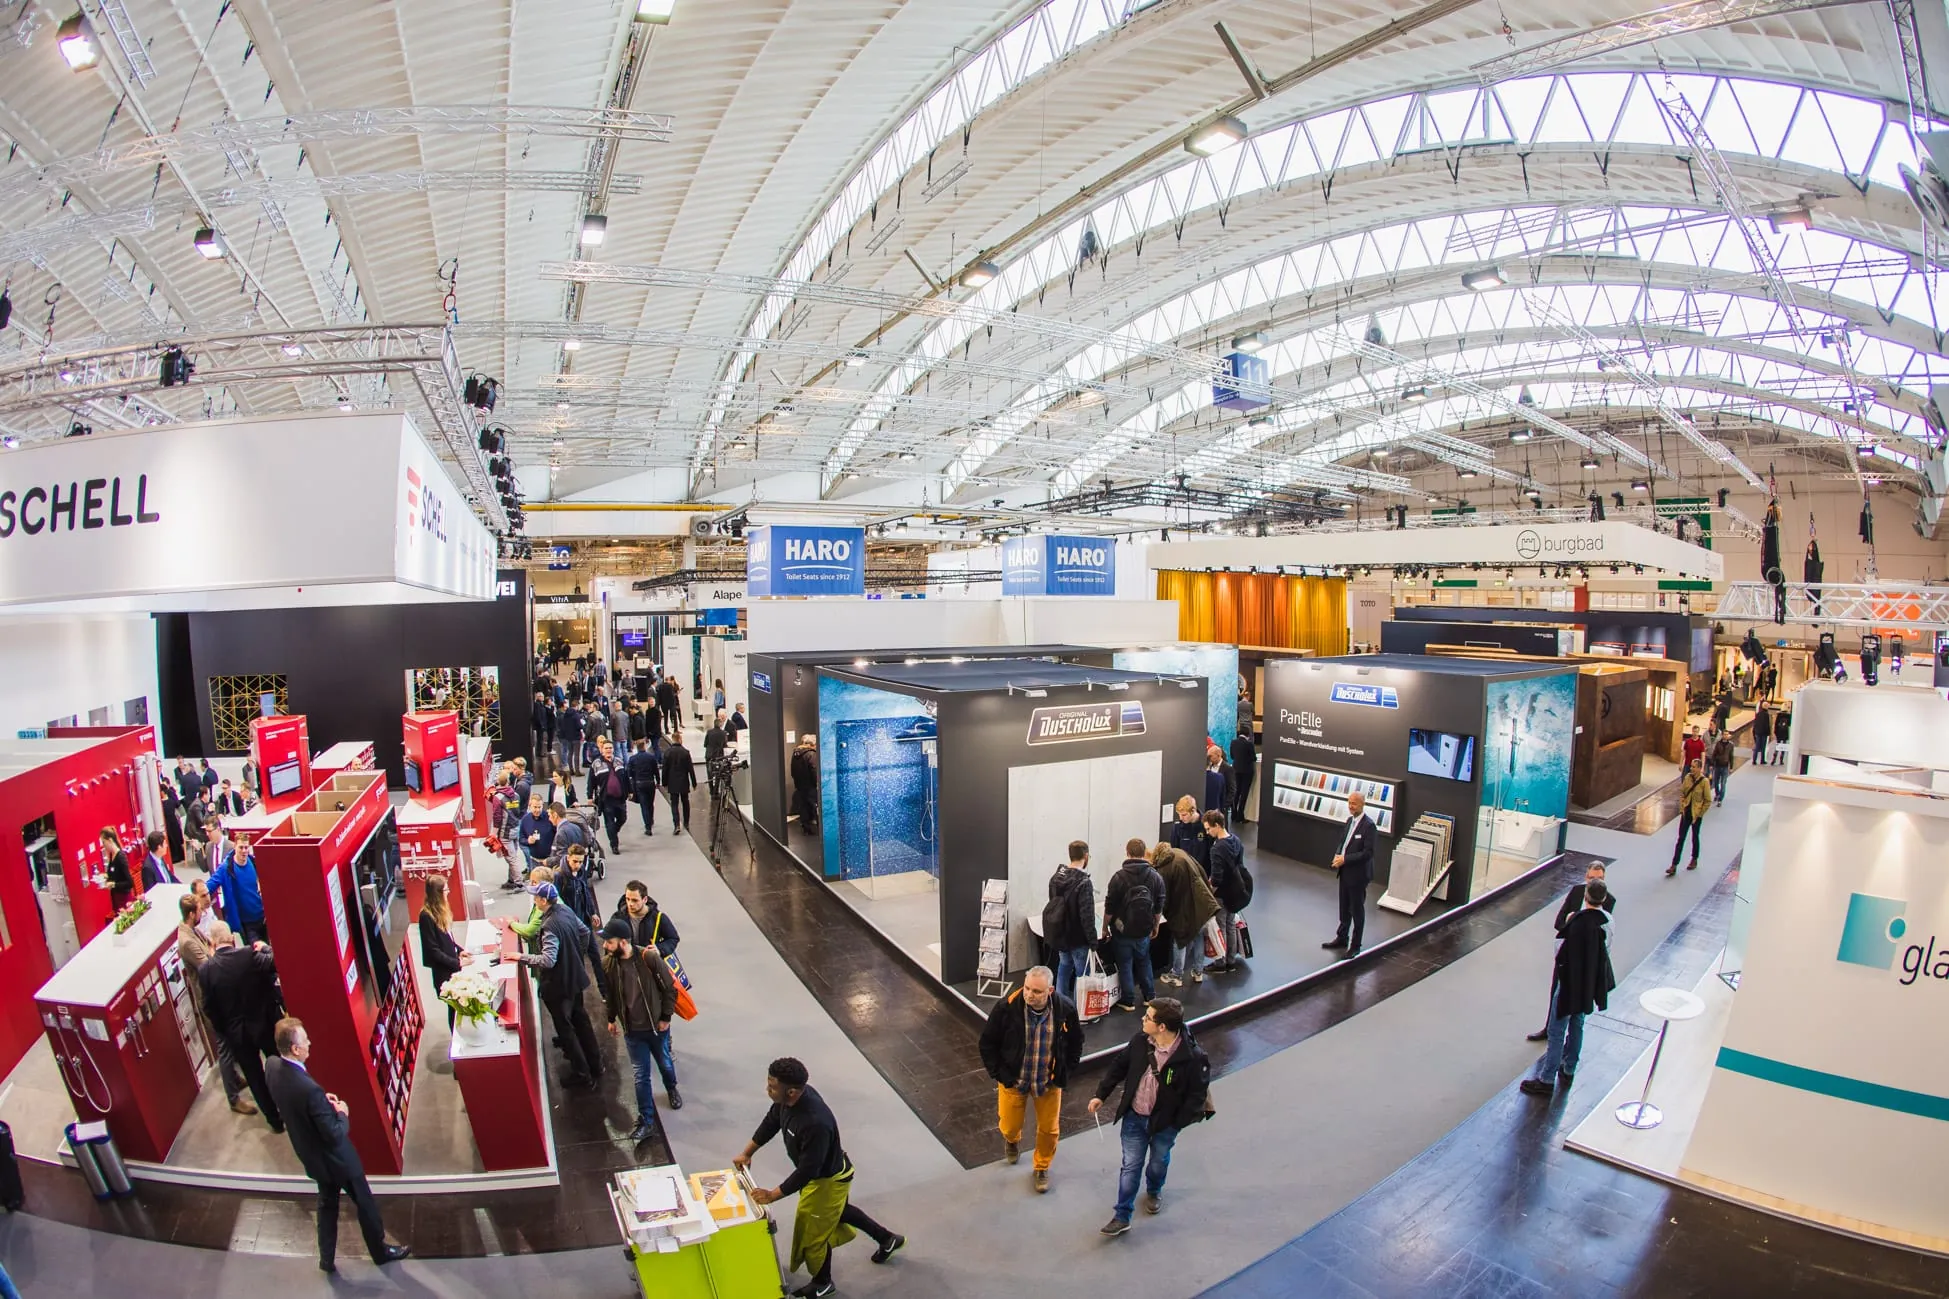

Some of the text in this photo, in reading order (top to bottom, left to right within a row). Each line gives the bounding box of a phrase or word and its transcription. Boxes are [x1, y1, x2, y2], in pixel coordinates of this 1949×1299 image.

[0, 474, 160, 538] SCHELL
[422, 485, 447, 543] SCHELL
[785, 539, 850, 561] HARO
[1544, 534, 1604, 554] burgbad
[1008, 547, 1039, 567] HARO
[1057, 547, 1105, 566] HARO
[713, 590, 742, 601] Alape
[1059, 711, 1088, 719] ORIGINAL
[1280, 708, 1322, 728] PanElle
[1899, 935, 1949, 985] gla
